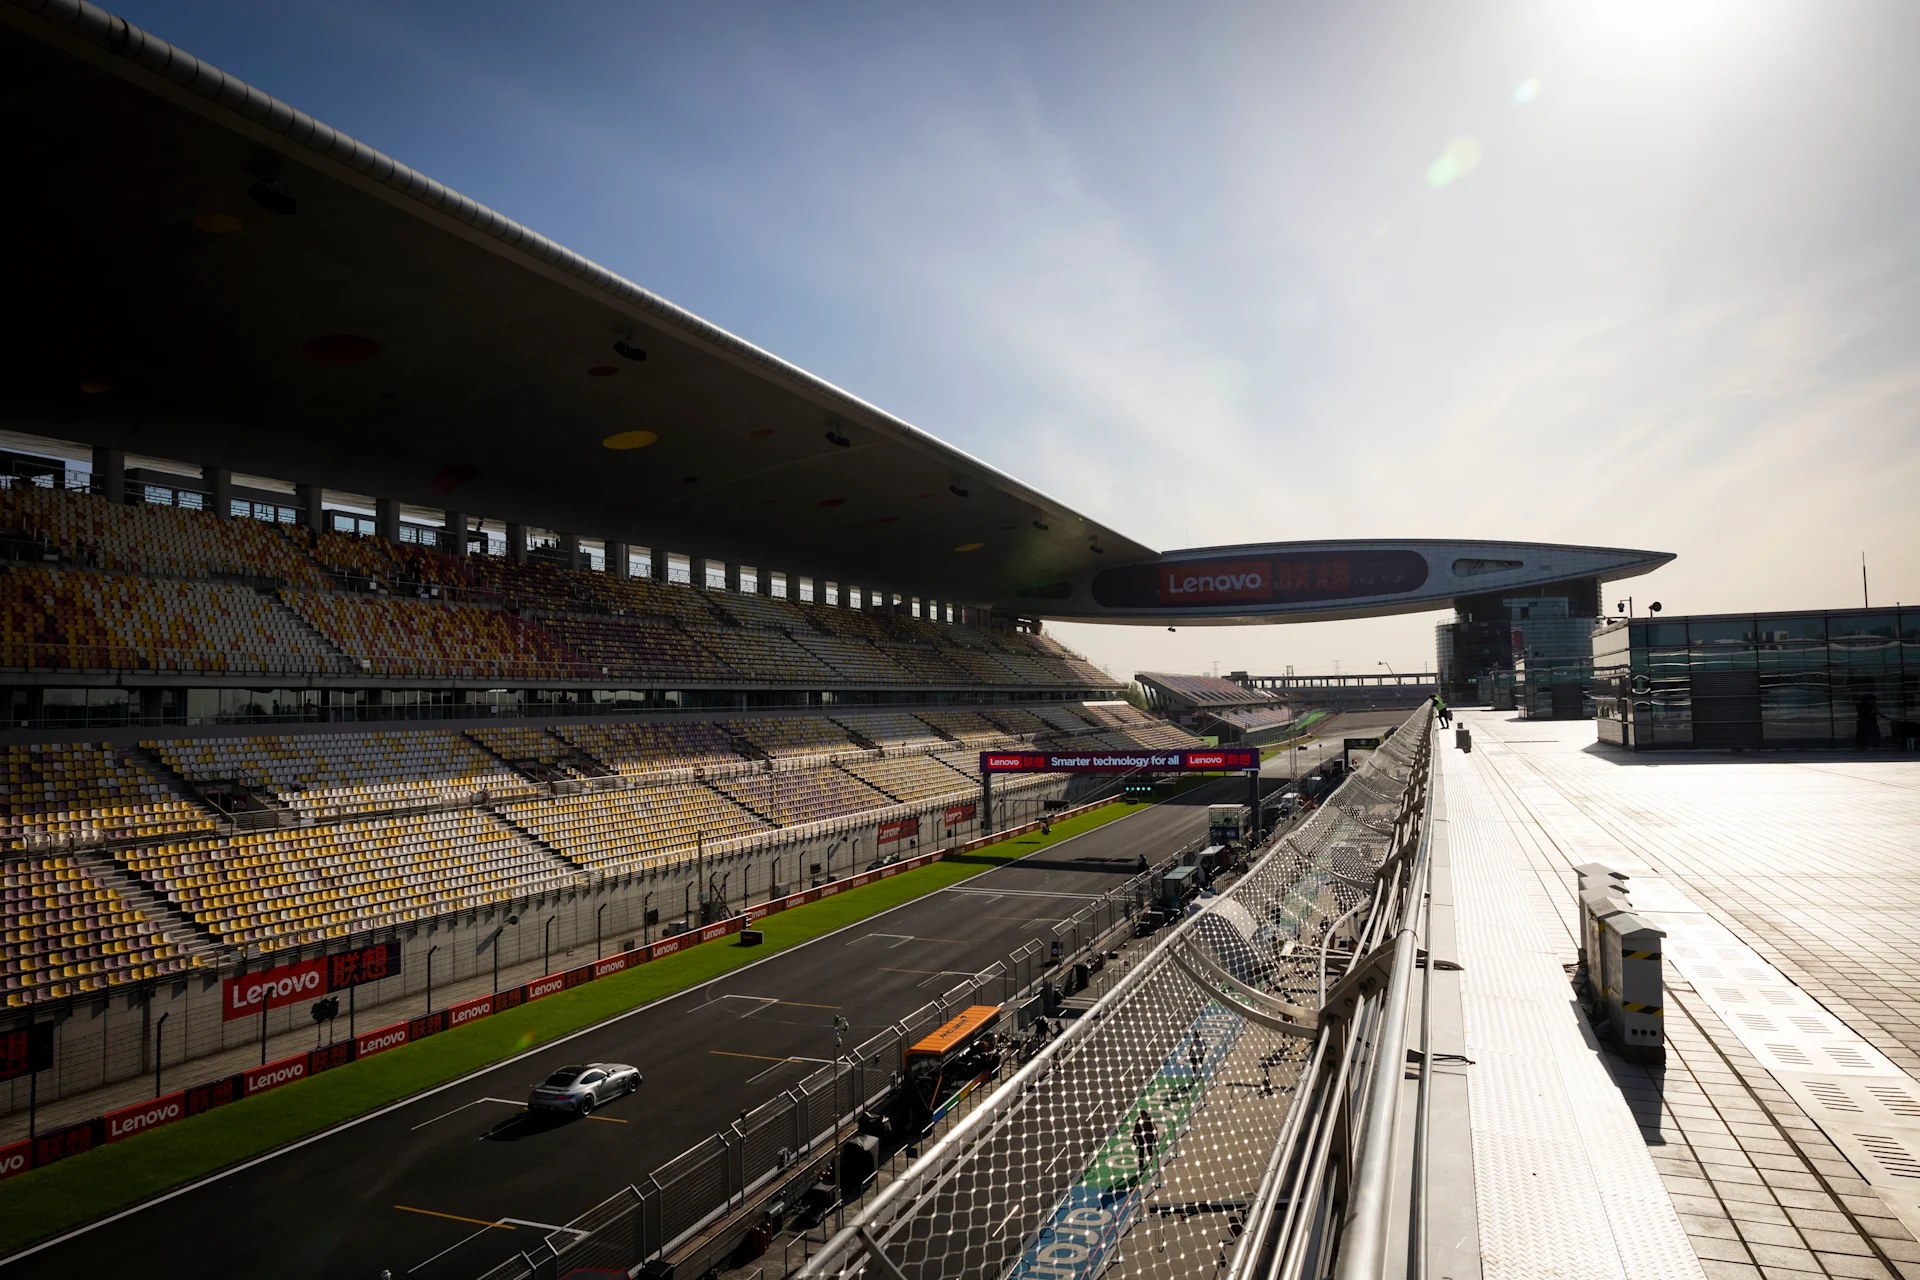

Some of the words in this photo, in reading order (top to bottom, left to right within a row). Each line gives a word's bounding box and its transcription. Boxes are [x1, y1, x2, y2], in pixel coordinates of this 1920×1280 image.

[1169, 573, 1262, 594] Lenovo
[990, 758, 1020, 766] Lenovo
[1051, 756, 1090, 766] Smarter
[1094, 756, 1149, 767] technology
[1151, 755, 1167, 765] for
[1168, 755, 1179, 765] all
[1189, 756, 1222, 764] Lenovo
[703, 926, 726, 941] Lenovo
[653, 941, 679, 958] Lenovo
[333, 943, 388, 988] 联想
[596, 959, 625, 976] Lenovo
[233, 971, 320, 1009] Lenovo
[530, 979, 563, 998] Lenovo
[451, 1001, 490, 1024] Lenovo
[360, 1030, 406, 1054] Lenovo
[249, 1063, 304, 1092] Lenovo
[111, 1104, 179, 1136] Lenovo
